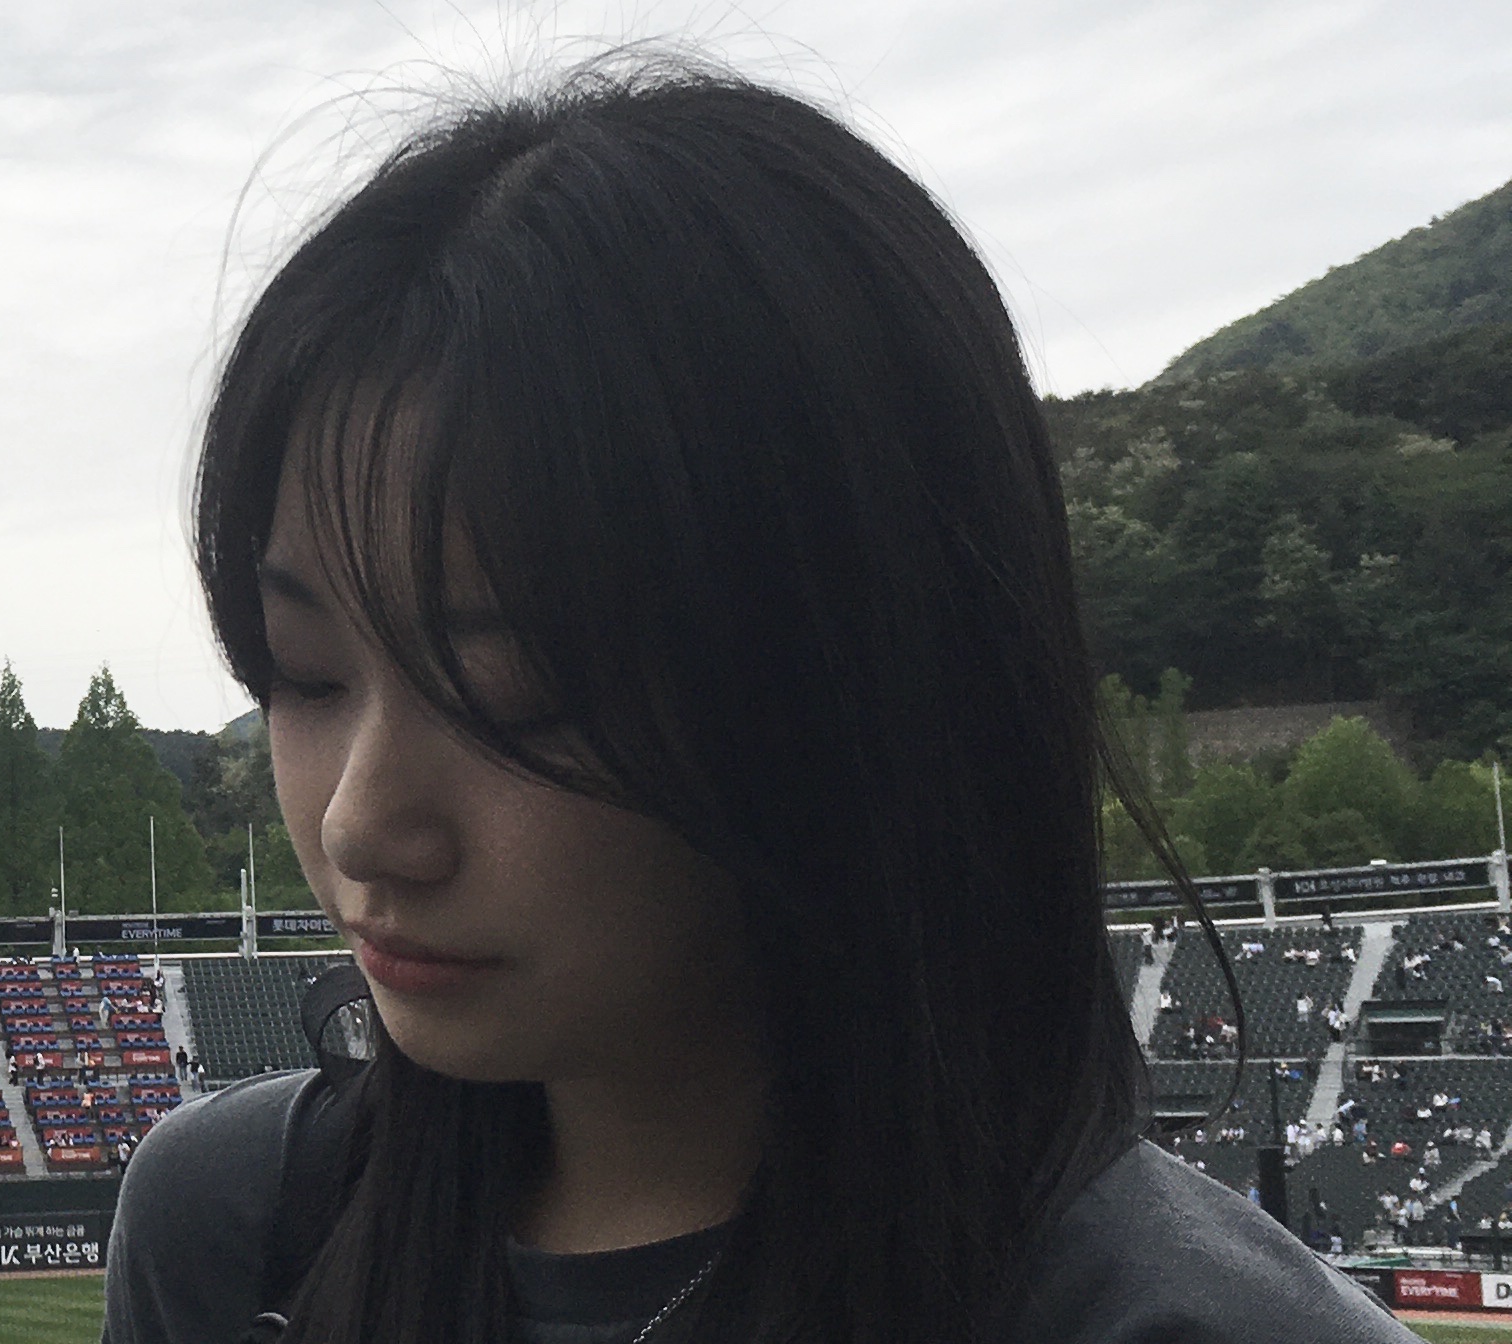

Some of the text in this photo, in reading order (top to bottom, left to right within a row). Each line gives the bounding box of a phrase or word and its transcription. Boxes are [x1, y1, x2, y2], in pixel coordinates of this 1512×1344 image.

[272, 918, 335, 932] 롯데자이언
[46, 1226, 65, 1238] 하는
[24, 1241, 99, 1265] 부산은행
